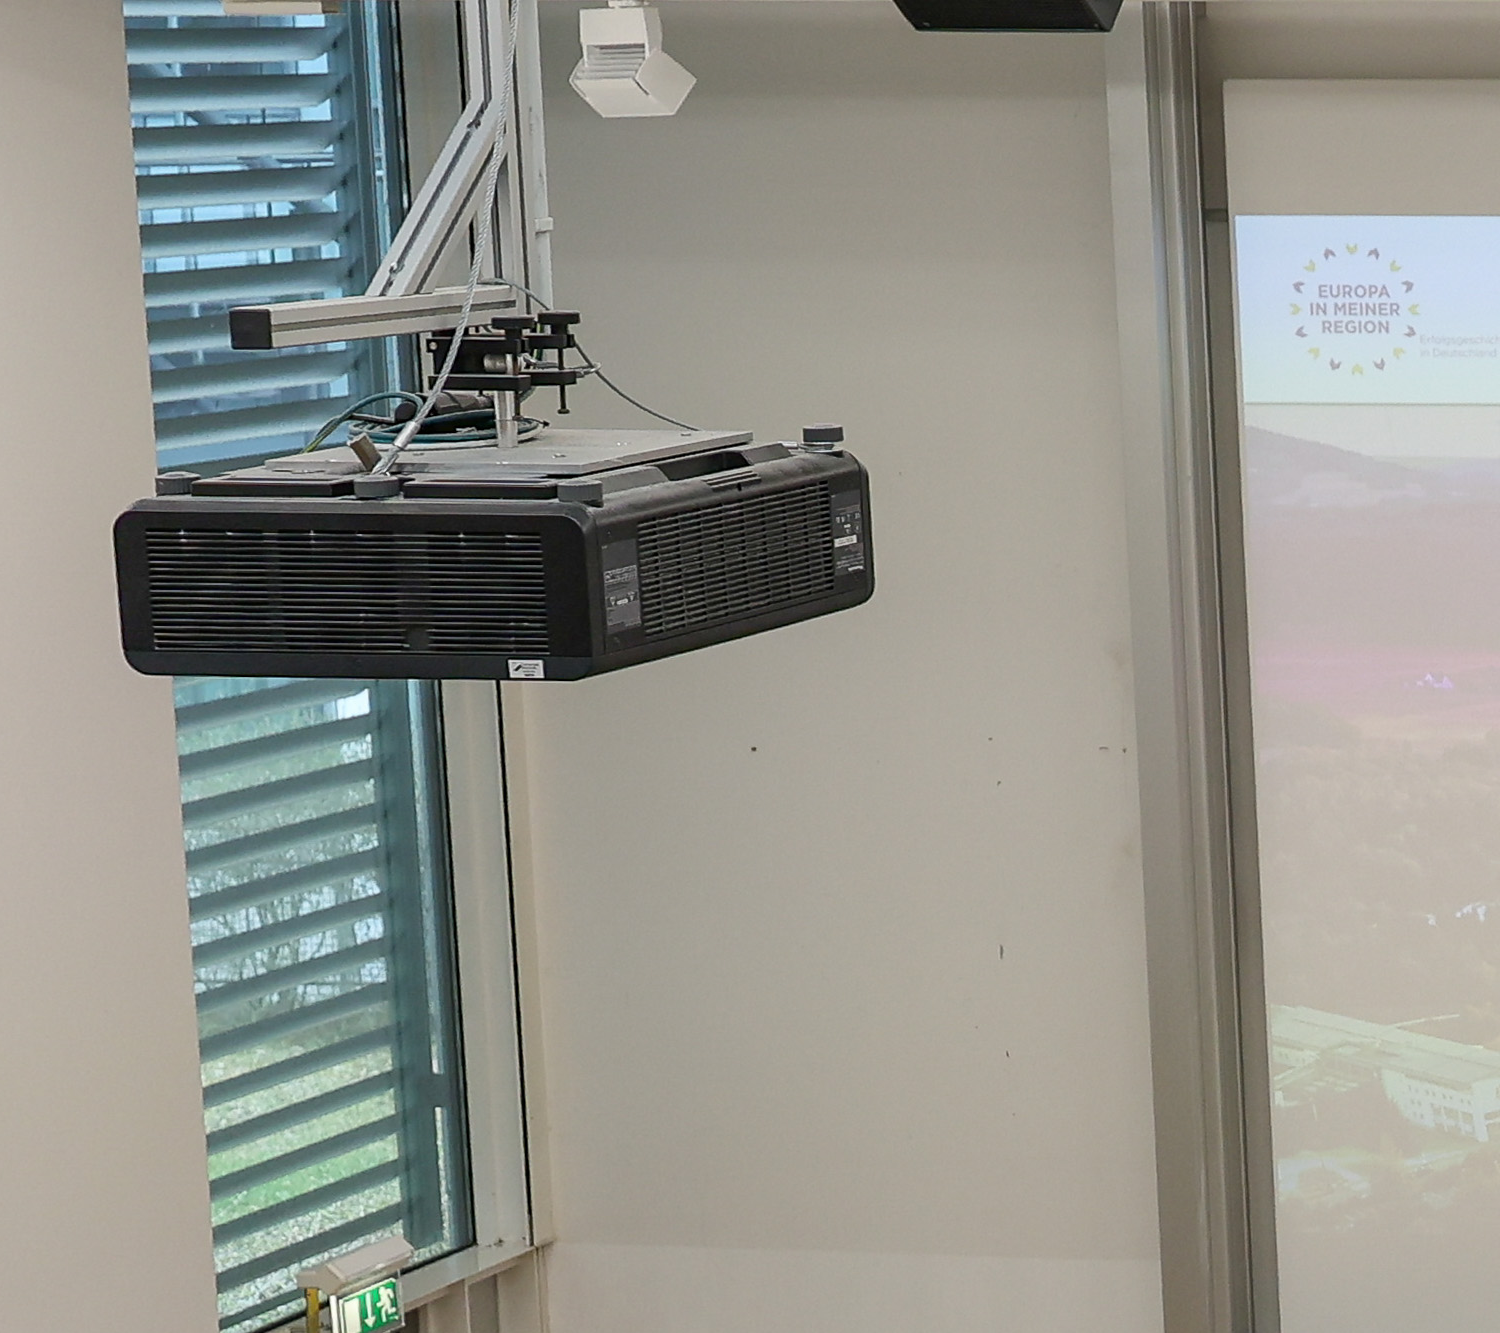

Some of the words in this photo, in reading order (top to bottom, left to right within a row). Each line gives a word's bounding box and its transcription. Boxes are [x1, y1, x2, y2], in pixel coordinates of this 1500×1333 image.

[1318, 284, 1391, 299] EUROPA
[1309, 302, 1328, 317] IN
[1333, 302, 1401, 317] MEINER
[1321, 320, 1391, 334] REGION
